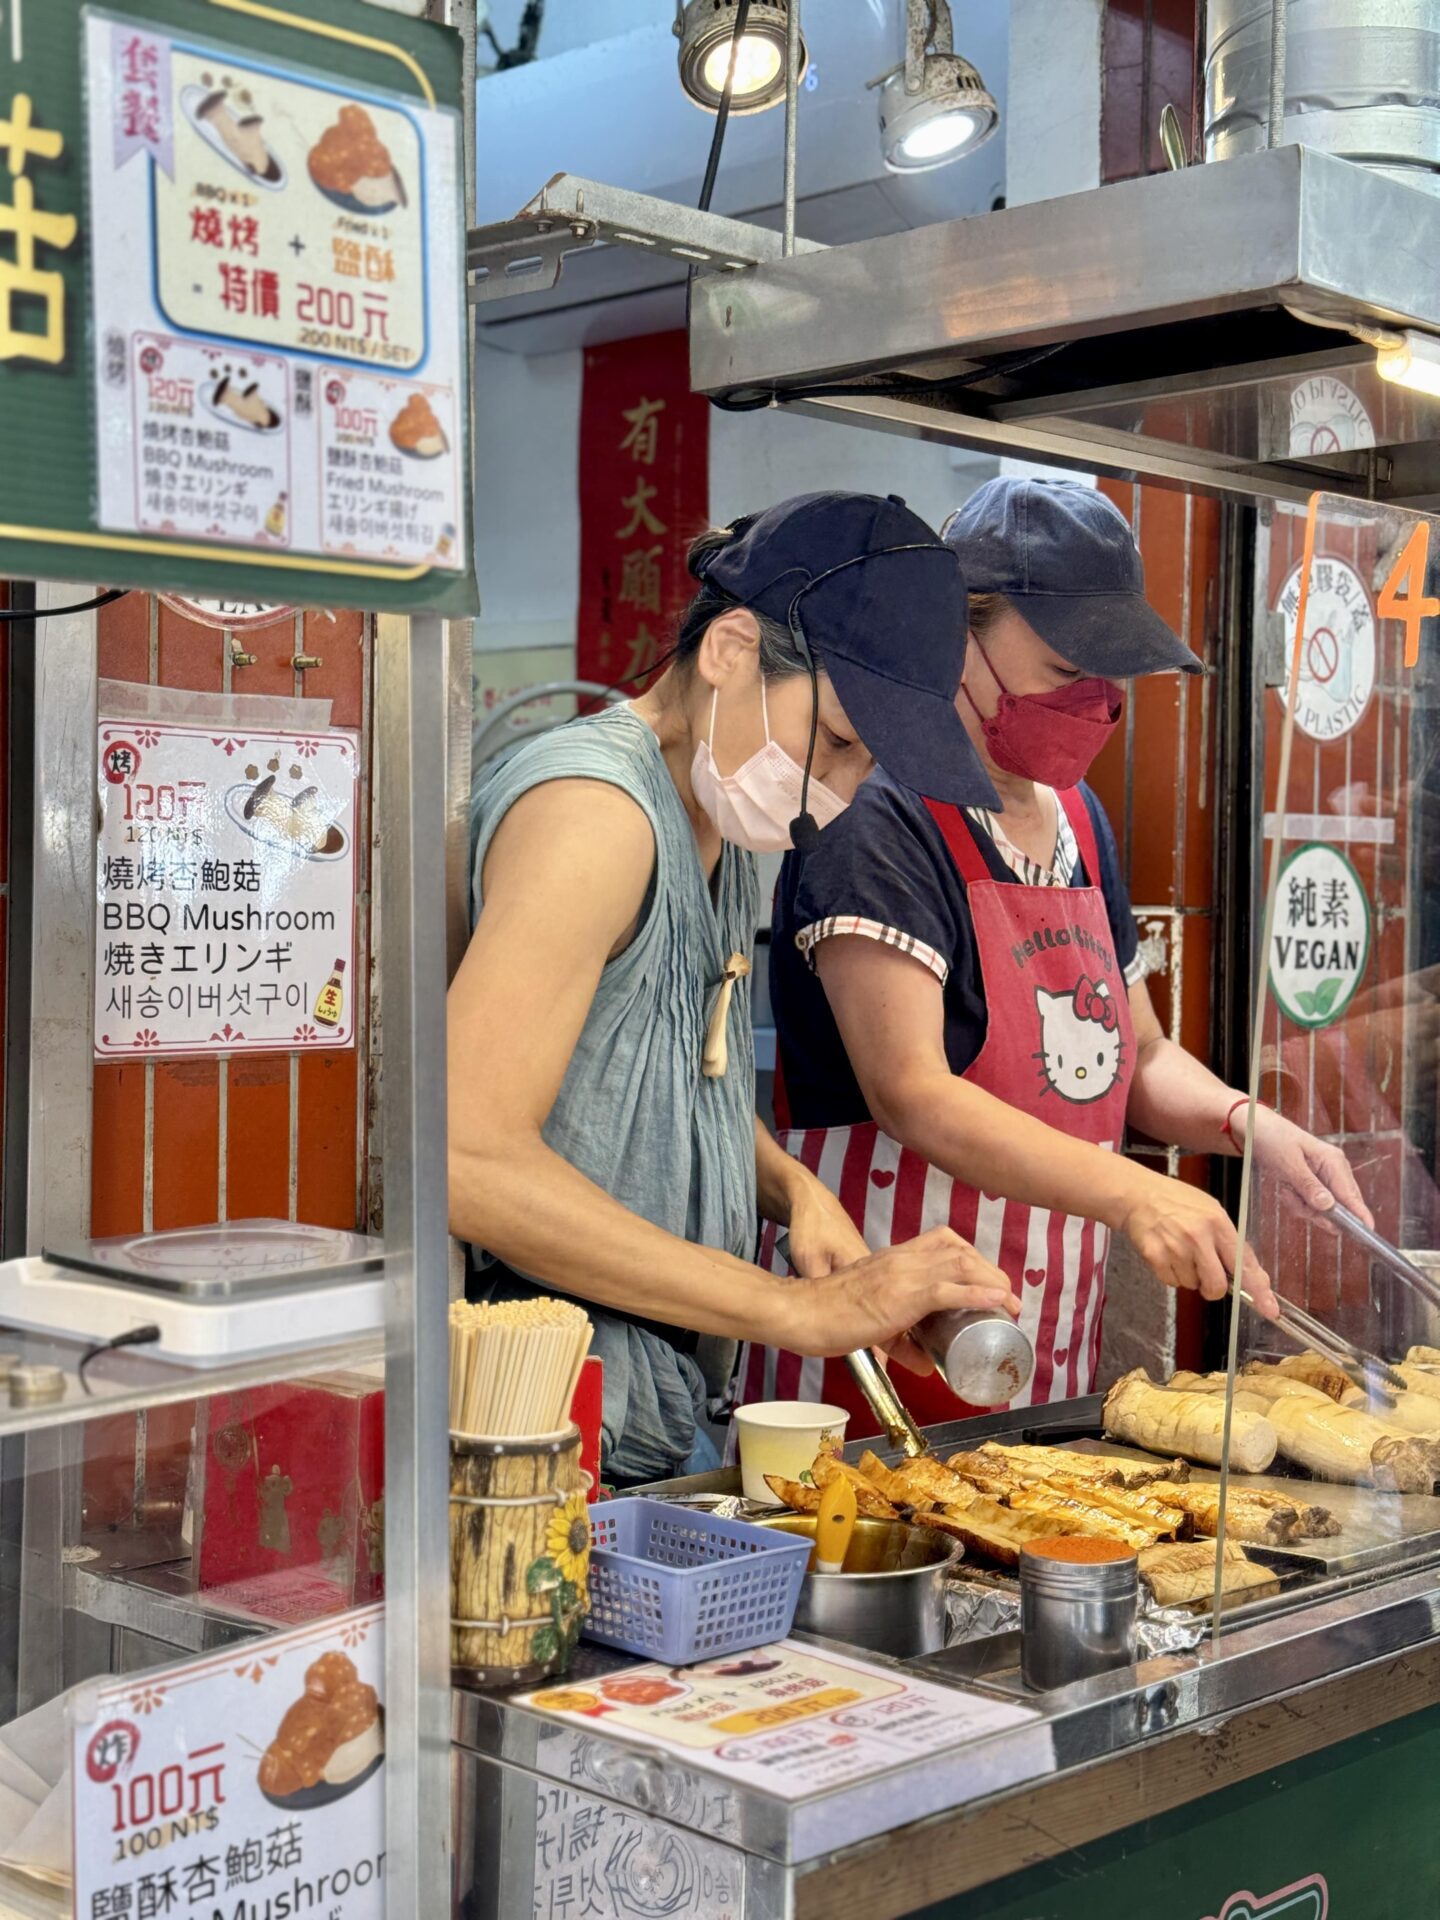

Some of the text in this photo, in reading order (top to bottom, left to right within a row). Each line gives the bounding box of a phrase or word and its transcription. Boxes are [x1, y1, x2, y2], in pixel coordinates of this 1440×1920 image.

[189, 205, 259, 256] 燒烤
[218, 261, 279, 320] 特價
[296, 283, 389, 341] 200元
[300, 325, 331, 343] 200
[148, 377, 195, 417] 120元
[335, 406, 378, 438] 100元
[143, 445, 274, 481] BBQ Mushroom
[327, 471, 445, 503] Fried Mushroom
[1377, 521, 1440, 668] 4
[1303, 684, 1368, 736] PLASTIC
[110, 750, 132, 775] 烤
[103, 855, 261, 892] 燒烤杏鮑菇
[103, 902, 336, 936] BBQ Mushroom
[1287, 876, 1350, 929] 純素
[104, 941, 292, 977] 焼きエリンギ
[1273, 935, 1359, 971] VEGAN
[105, 981, 308, 1020] 새송이버섯구이
[111, 1742, 225, 1833] 100元
[115, 1805, 219, 1861] 100 NT$
